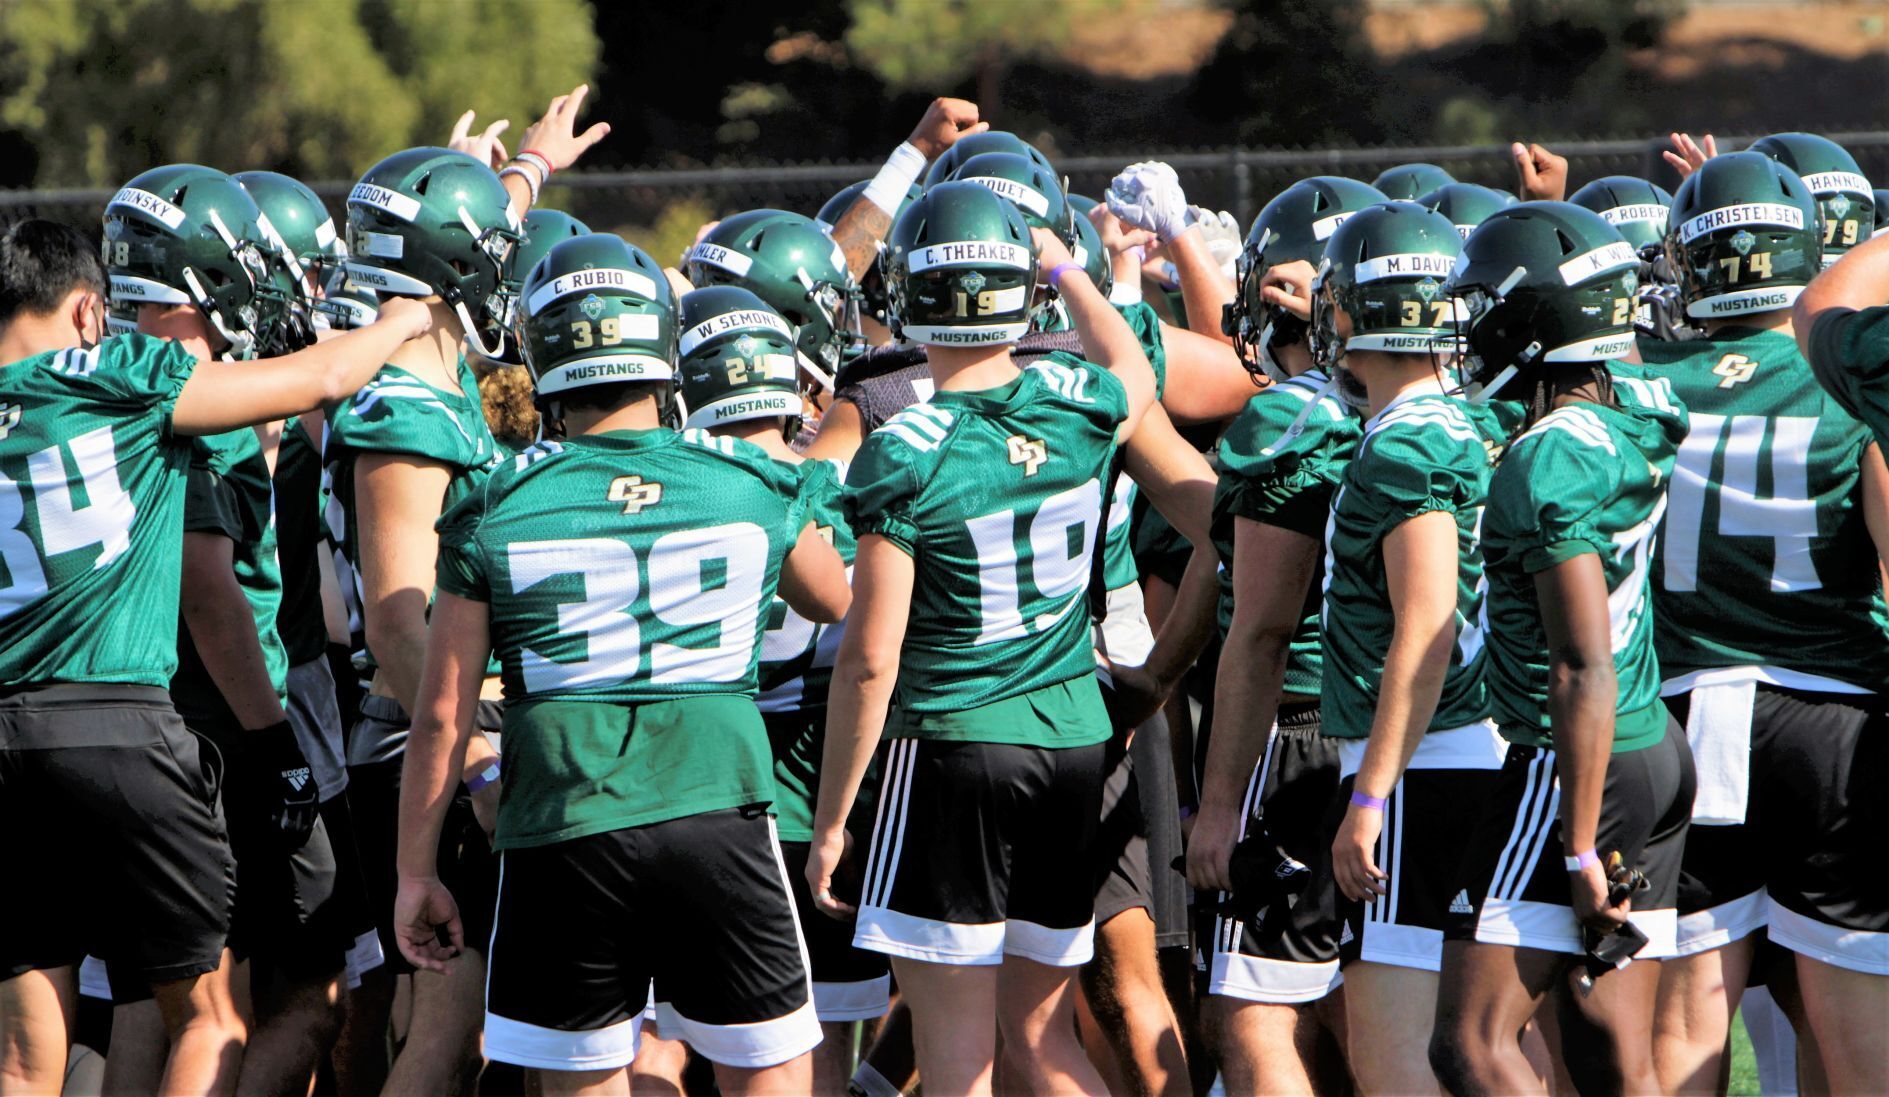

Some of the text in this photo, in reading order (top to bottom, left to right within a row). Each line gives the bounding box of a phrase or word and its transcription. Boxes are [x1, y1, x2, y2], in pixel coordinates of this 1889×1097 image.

[116, 189, 170, 217] DINSKY
[1620, 207, 1669, 220] ROBER
[926, 244, 1016, 265] C. THEAKER
[1387, 258, 1406, 273] M.
[1720, 252, 1772, 283] 74
[554, 271, 624, 294] C. RUBIO
[956, 291, 996, 318] 19
[1401, 301, 1449, 327] 37
[1711, 294, 1788, 313] MUSTANGS
[571, 318, 622, 350] 39
[698, 323, 718, 338] W.
[931, 331, 1008, 343] MUSTANGS
[565, 363, 644, 382] MUSTANGS
[726, 355, 770, 386] 24
[715, 398, 786, 420] MUSTANGS
[965, 477, 1101, 646] 19
[507, 521, 770, 693] 39
